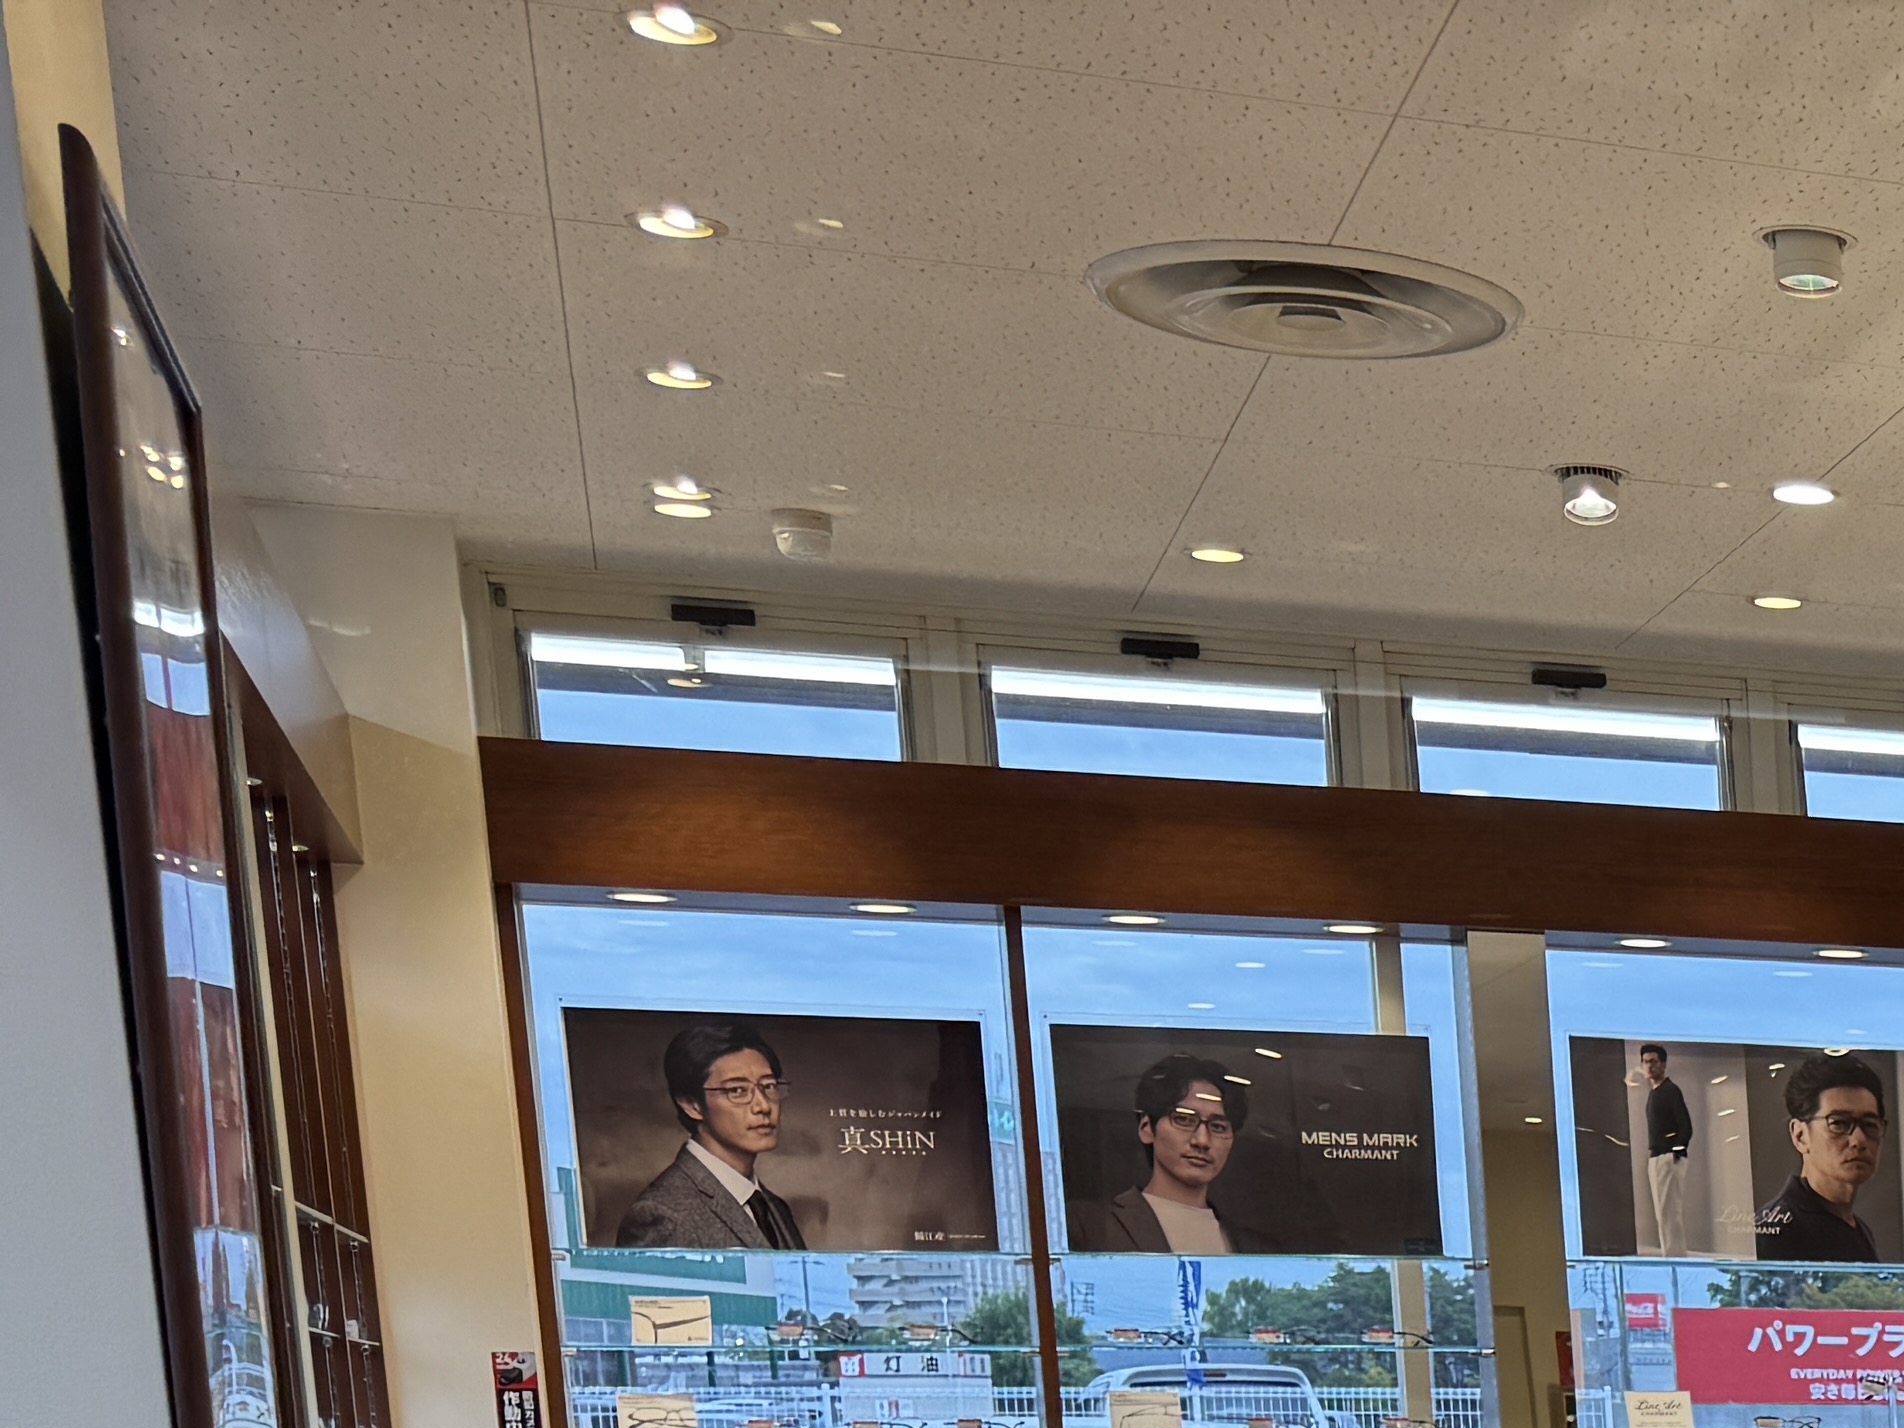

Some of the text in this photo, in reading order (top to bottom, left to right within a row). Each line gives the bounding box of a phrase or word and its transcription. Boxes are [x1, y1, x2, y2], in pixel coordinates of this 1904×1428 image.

[1301, 1131, 1418, 1148] MENS MARK
[1323, 1148, 1400, 1160] CHARMANT
[1727, 1226, 1781, 1236] CHARMANT
[884, 1355, 940, 1373] 灯油
